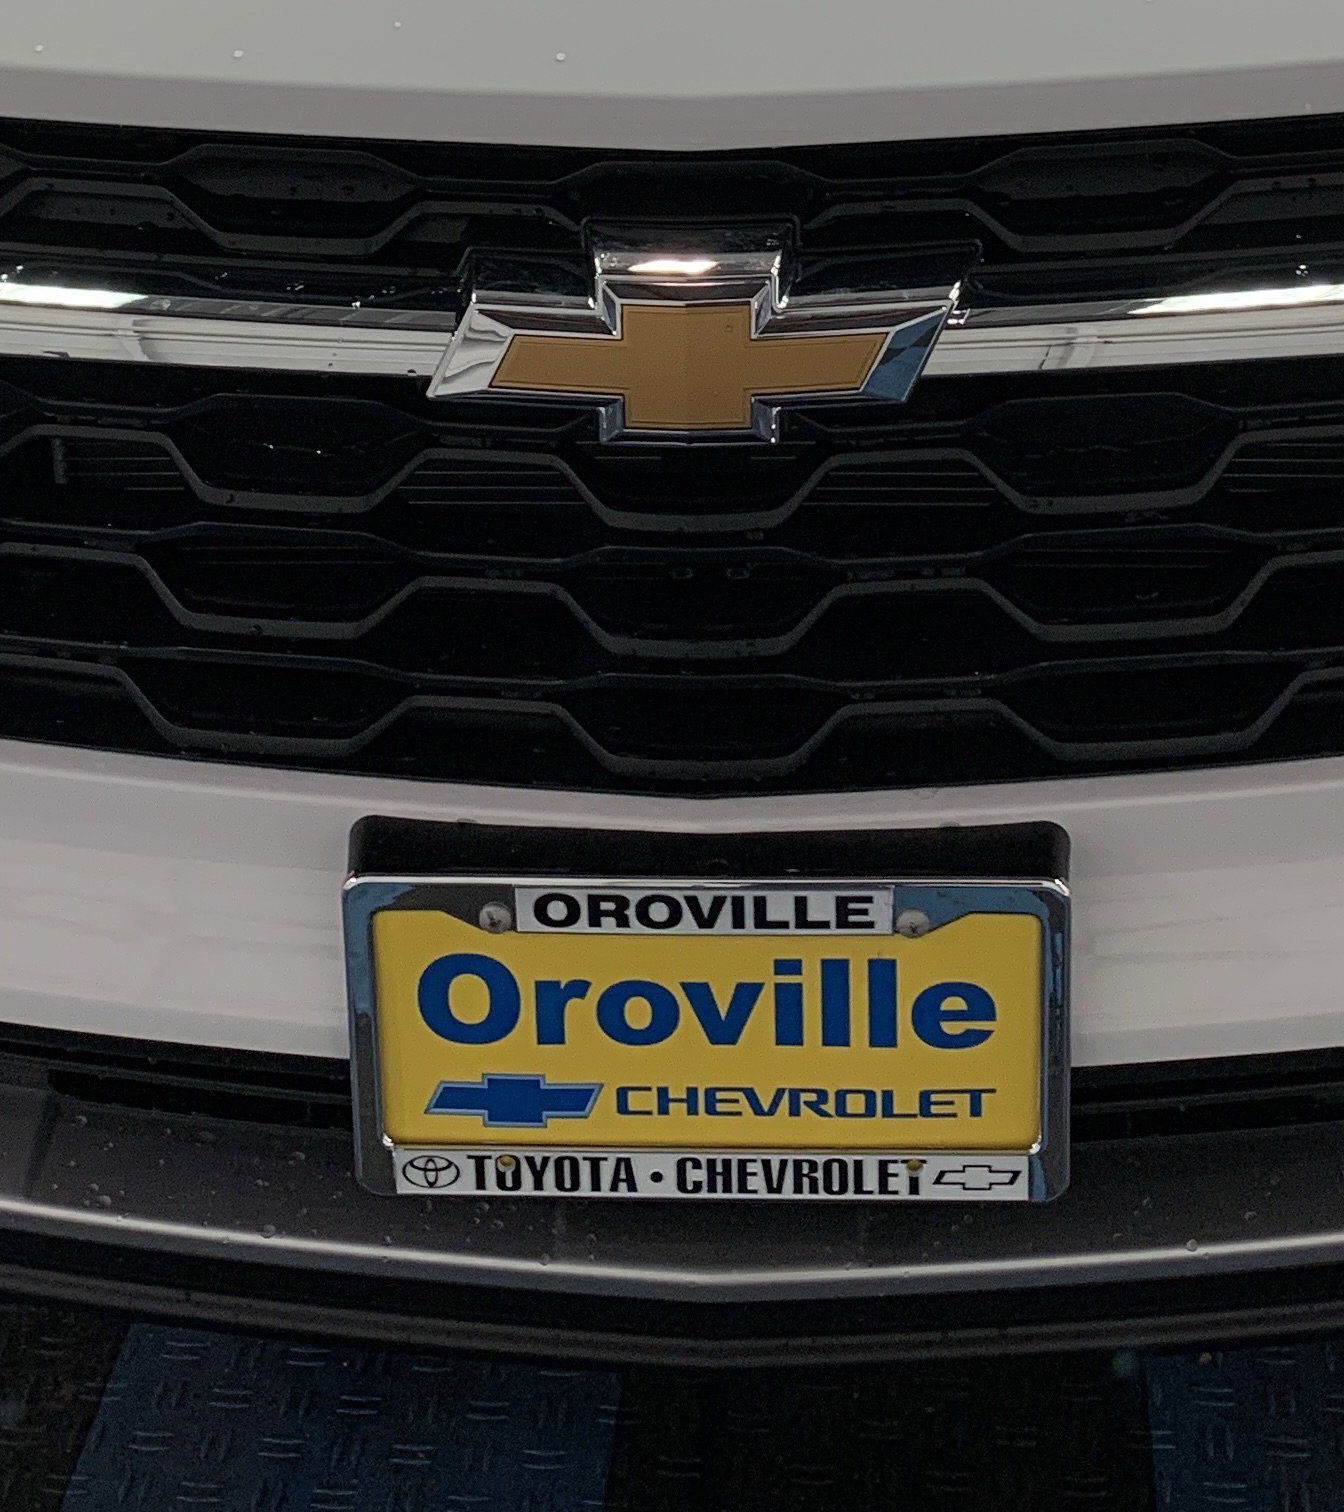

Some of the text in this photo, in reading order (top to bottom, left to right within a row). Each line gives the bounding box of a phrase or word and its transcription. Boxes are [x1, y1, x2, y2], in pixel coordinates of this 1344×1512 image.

[533, 892, 876, 931] OROVILLE
[417, 952, 998, 1050] Oroville
[615, 1086, 998, 1119] CHEVROLET
[467, 1153, 926, 1197] TOYOTA CHEVROLET
